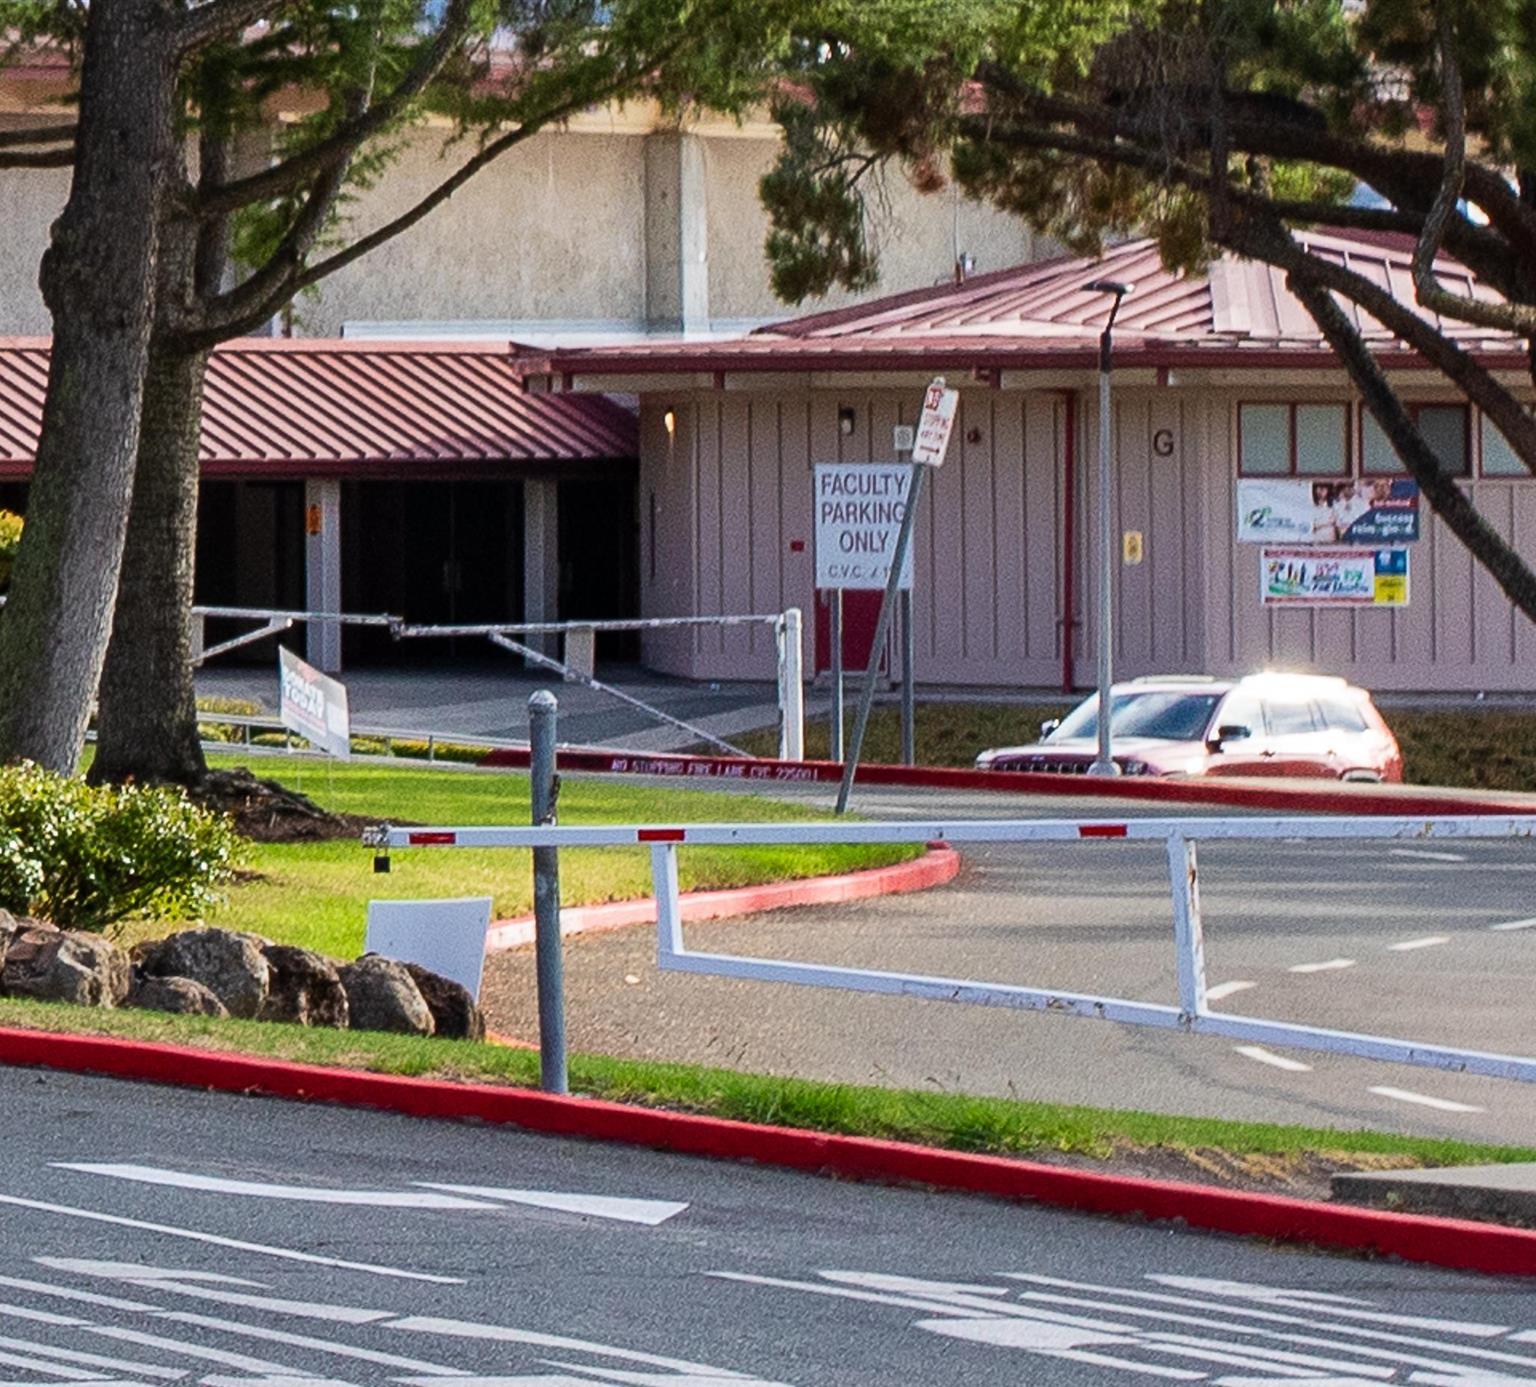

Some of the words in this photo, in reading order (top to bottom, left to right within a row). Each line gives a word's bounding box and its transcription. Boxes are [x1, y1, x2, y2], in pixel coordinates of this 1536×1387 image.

[1154, 429, 1174, 457] G
[820, 473, 906, 496] FACULTY
[839, 530, 889, 553] ONLY
[611, 759, 627, 771] NO
[687, 762, 713, 776] FIRE
